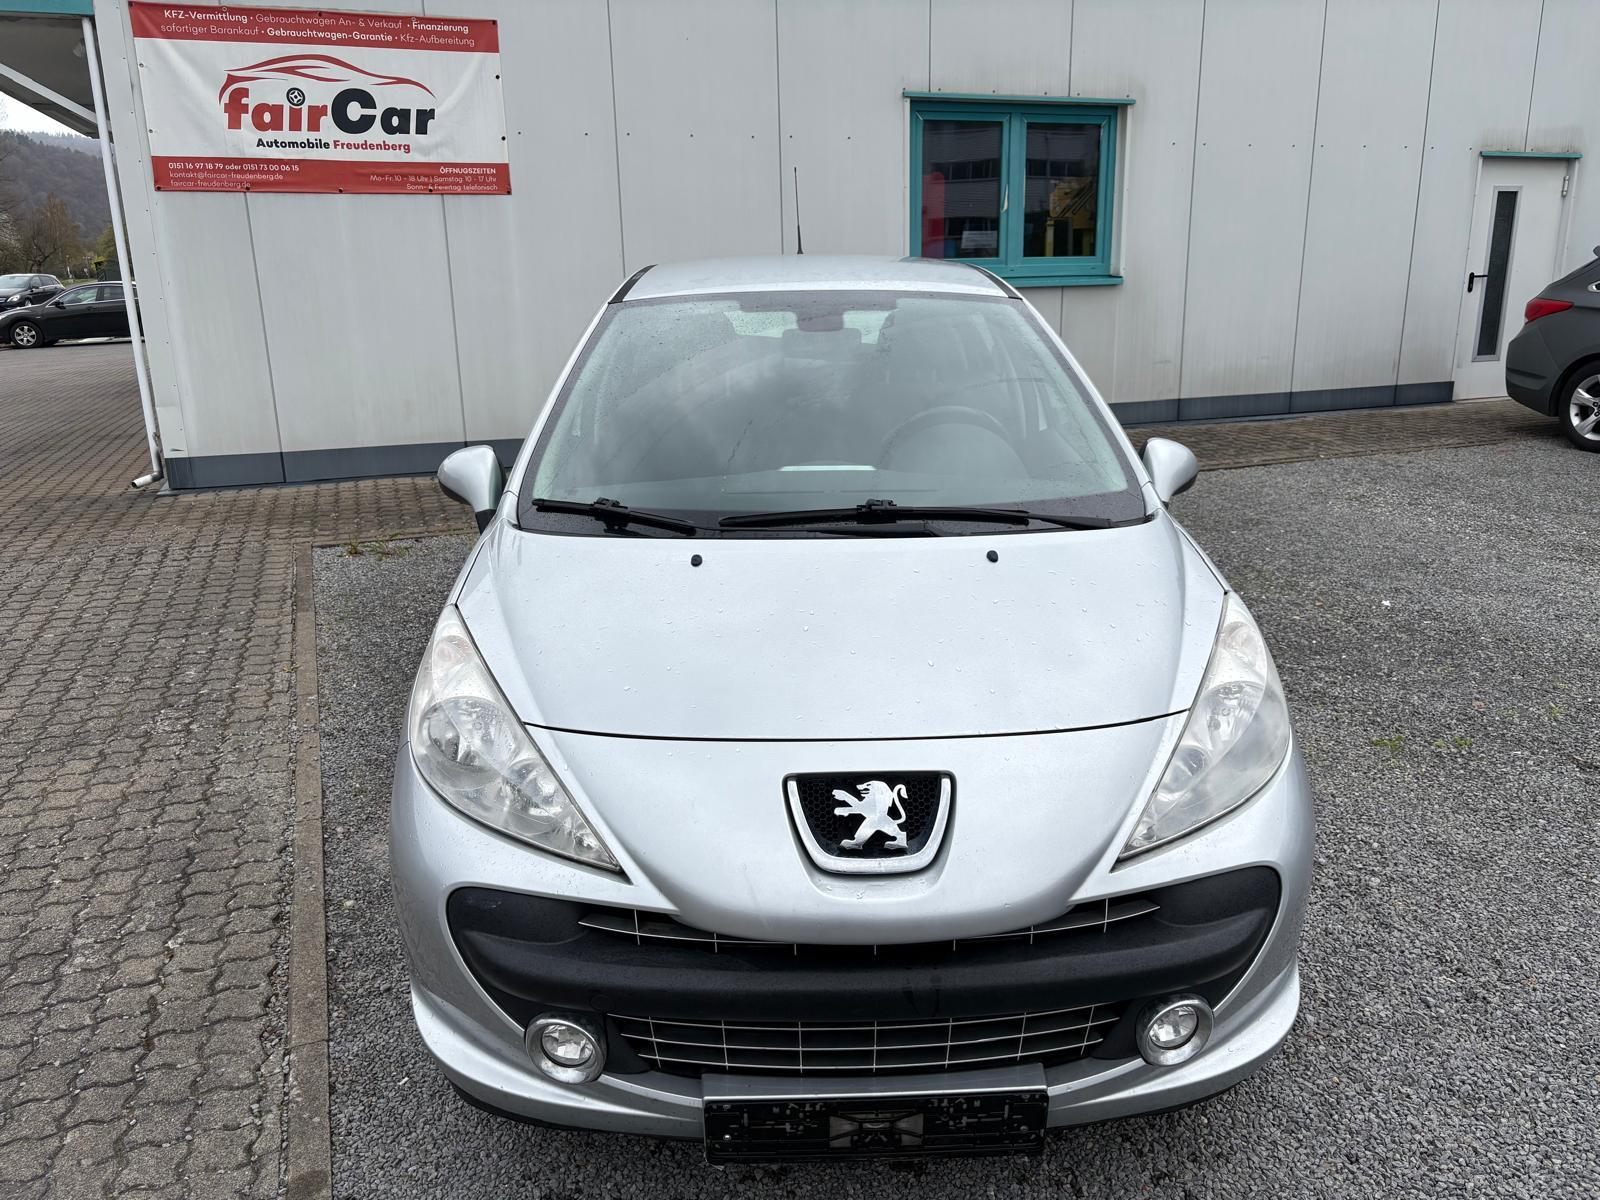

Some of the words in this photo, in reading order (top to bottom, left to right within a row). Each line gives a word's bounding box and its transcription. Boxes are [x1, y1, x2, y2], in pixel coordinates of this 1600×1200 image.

[164, 10, 248, 23] KFZ-Vermittlung
[256, 14, 336, 27] Gebrauchtwagen
[338, 17, 356, 26] An-
[358, 16, 366, 26] &
[368, 18, 402, 29] Verkauf
[412, 22, 469, 34] Finanzierung
[160, 24, 207, 35] sofortiger
[210, 26, 259, 36] Barankauf
[266, 28, 392, 42] Gebrauchtwagen-Garantie
[400, 34, 475, 47] Kfz-Aufbereitung
[224, 87, 436, 136] fairCar
[256, 138, 330, 150] Automobile
[333, 140, 411, 154] Freudenberg
